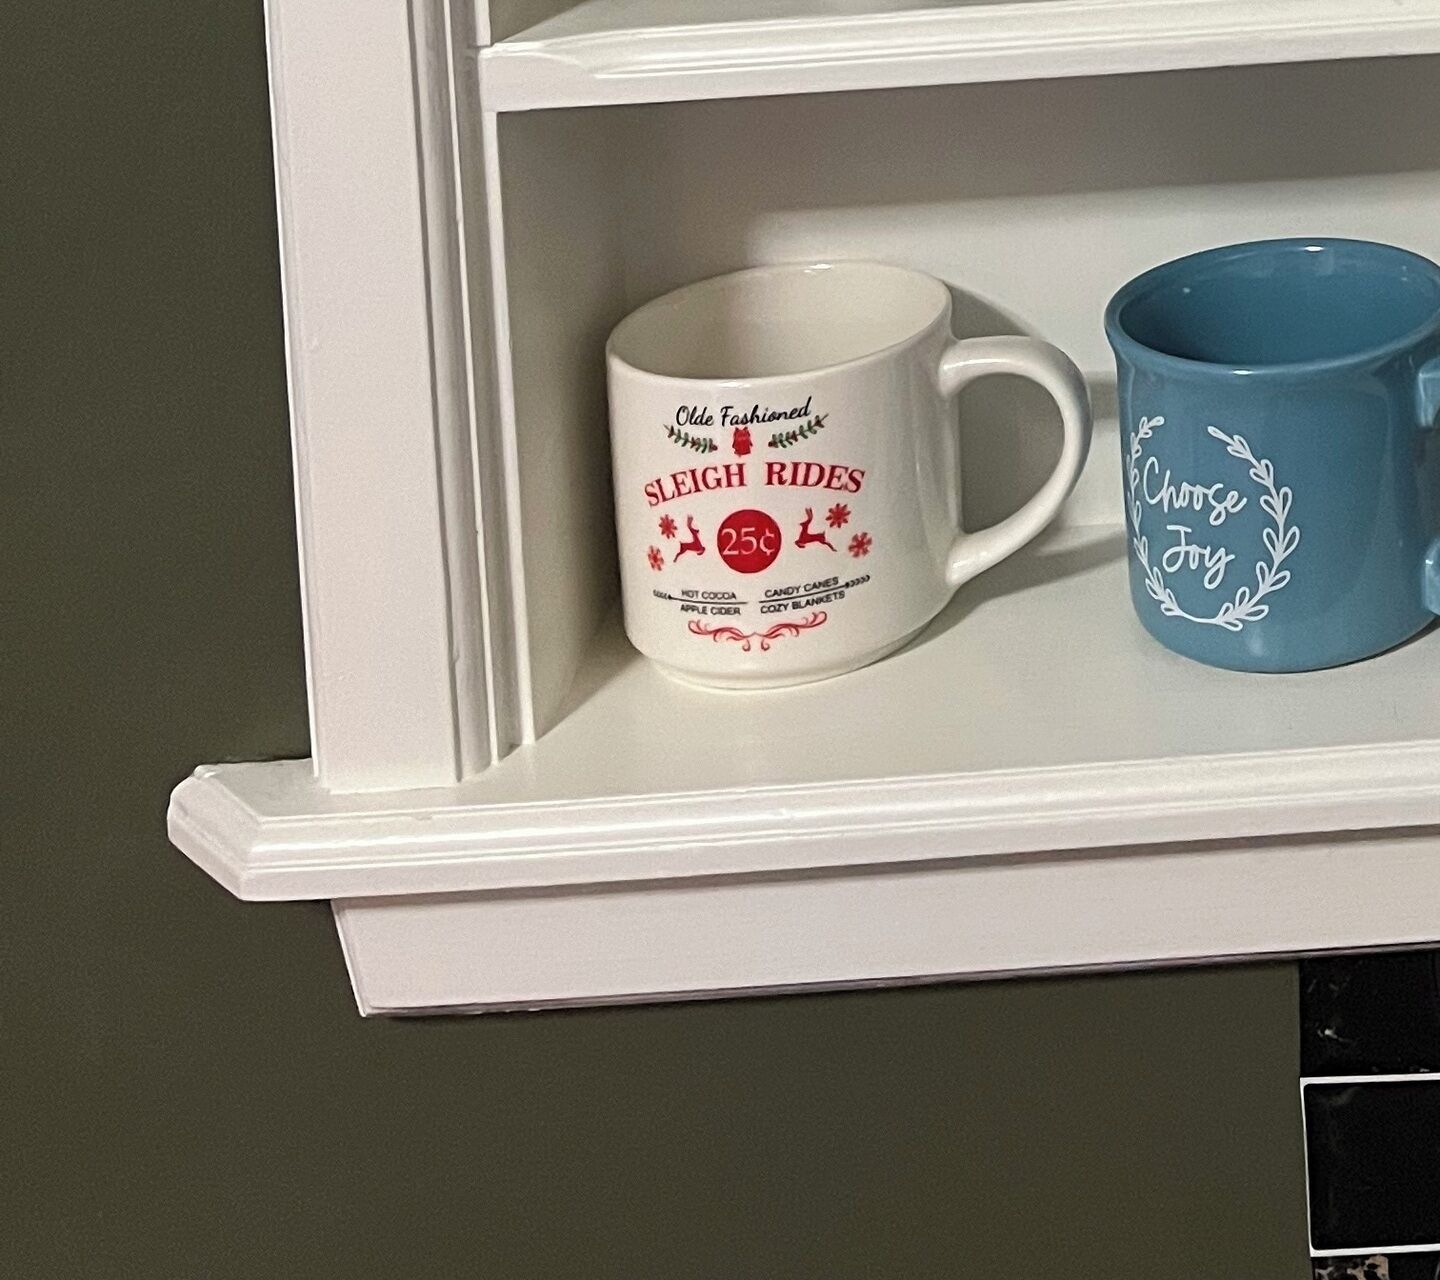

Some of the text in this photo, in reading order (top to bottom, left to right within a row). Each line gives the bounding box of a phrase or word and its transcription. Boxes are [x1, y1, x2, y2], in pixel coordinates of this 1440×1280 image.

[676, 396, 813, 427] Olde Fashioned
[644, 462, 865, 508] SLEIGH RIDES
[1143, 456, 1248, 526] Choose
[722, 527, 776, 557] 25¢
[1162, 524, 1236, 590] Joy
[681, 590, 737, 600] HOT COCOA
[764, 576, 840, 598] CANDY CANES
[680, 605, 741, 615] APPLE CIDER
[760, 591, 845, 615] COZY BLANKETS
